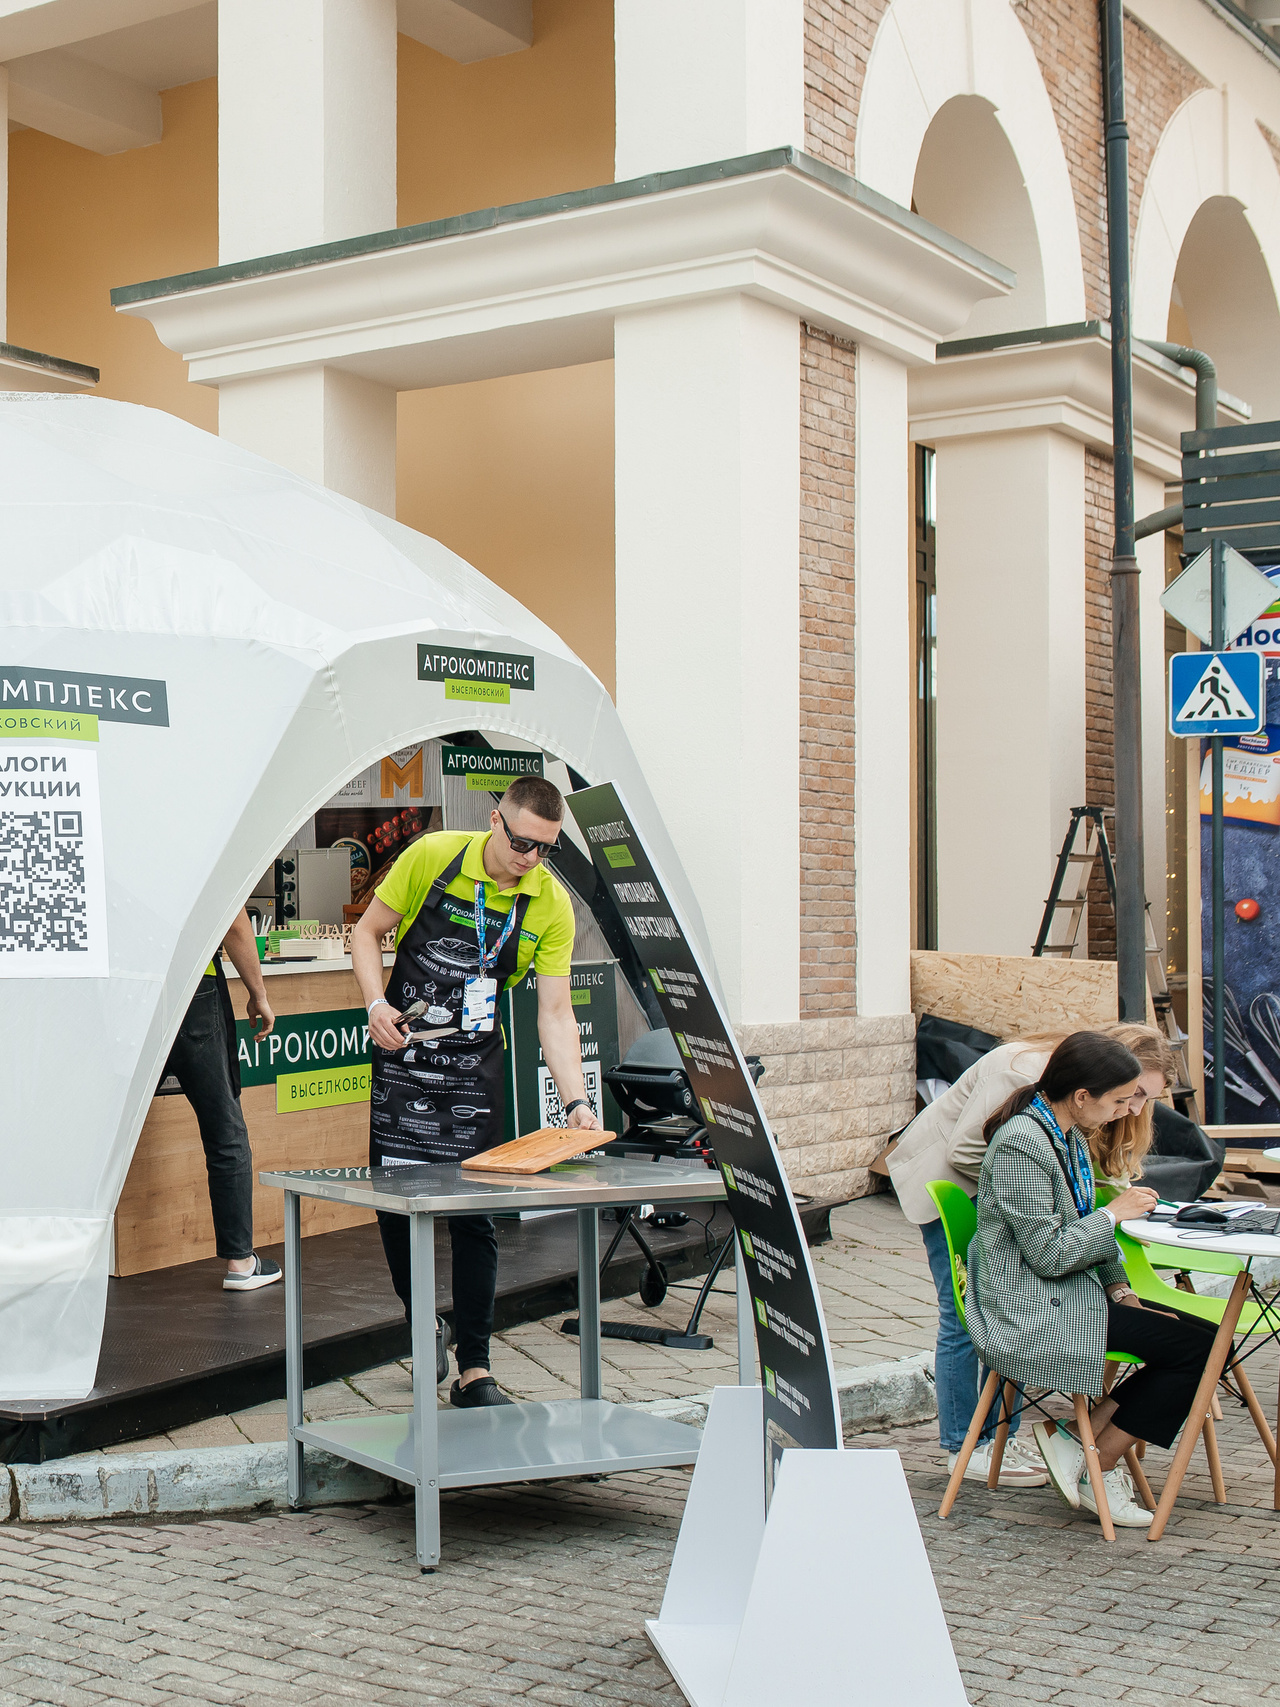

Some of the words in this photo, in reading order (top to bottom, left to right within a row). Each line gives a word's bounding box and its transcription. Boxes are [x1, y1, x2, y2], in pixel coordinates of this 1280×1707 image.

[423, 654, 530, 681] АГРОКОМПЛЕКС
[451, 685, 505, 698] ВЫСЕЛКОВСКИЙ
[447, 753, 540, 773] АГРОКОМПЛЕКС
[1225, 763, 1271, 775] ЧЕДДЕР
[442, 902, 503, 928] АГРОКОМЕКС
[526, 973, 604, 990] АГПЛЕКС
